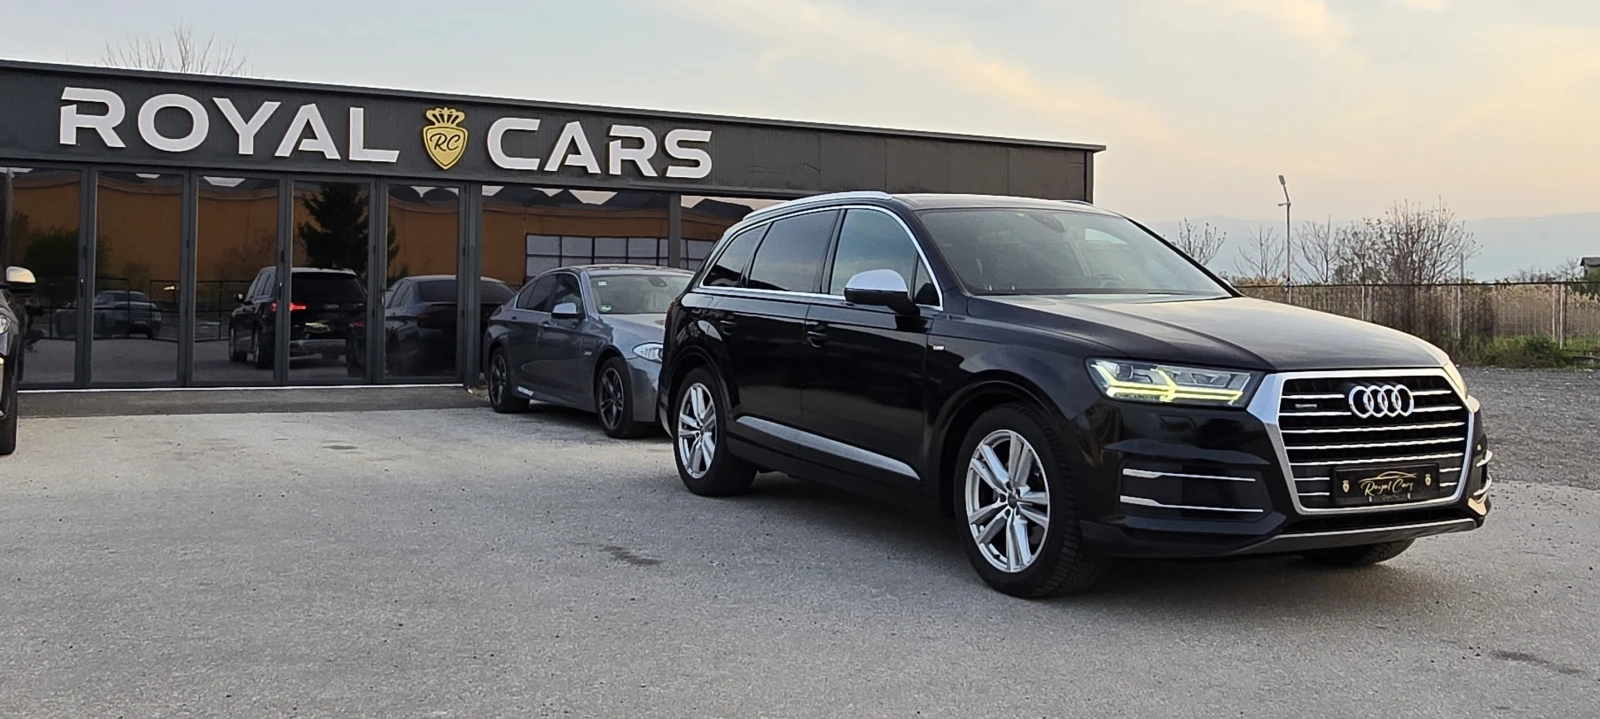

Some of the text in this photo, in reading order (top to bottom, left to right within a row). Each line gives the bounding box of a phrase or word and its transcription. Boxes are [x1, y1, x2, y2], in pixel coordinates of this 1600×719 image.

[59, 86, 713, 179] ROYAL CARS
[429, 132, 461, 152] RC
